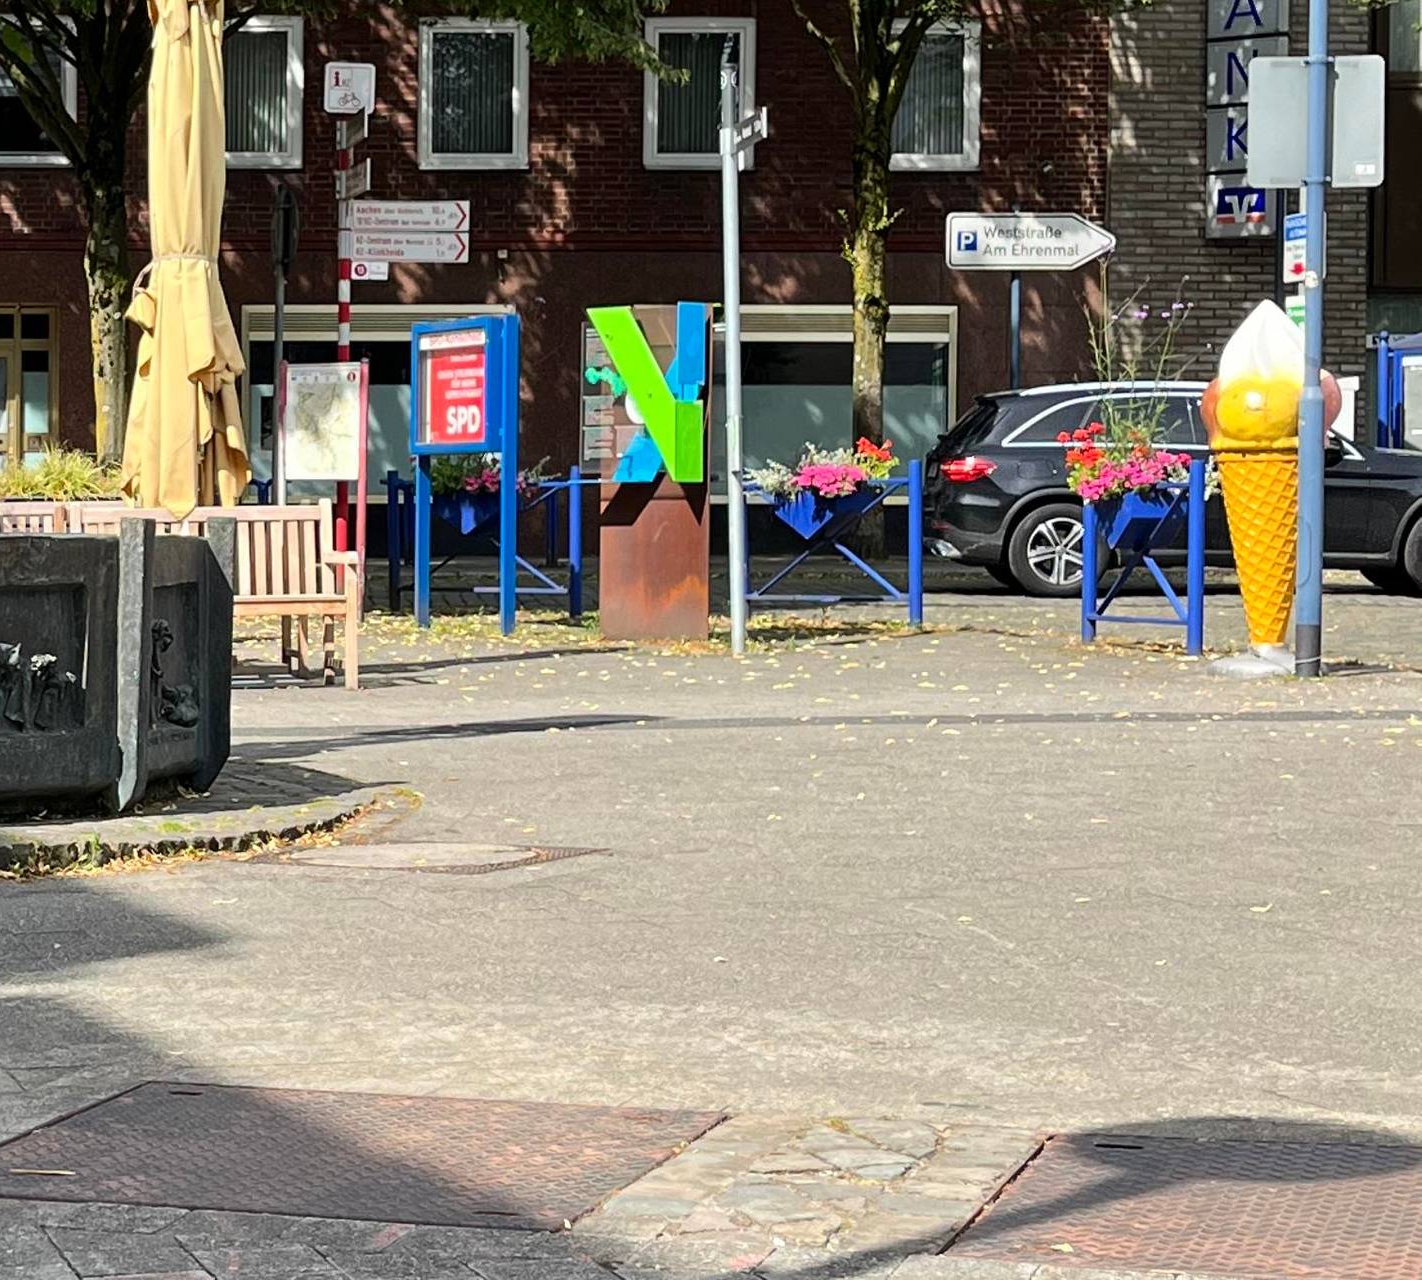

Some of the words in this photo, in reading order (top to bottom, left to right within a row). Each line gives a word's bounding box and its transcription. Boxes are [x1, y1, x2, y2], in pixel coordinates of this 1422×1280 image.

[356, 206, 381, 214] Aachen
[983, 226, 1062, 239] Weststraße
[983, 245, 1007, 257] Am
[1012, 244, 1079, 257] Ehrenmal
[446, 405, 481, 435] SPD
